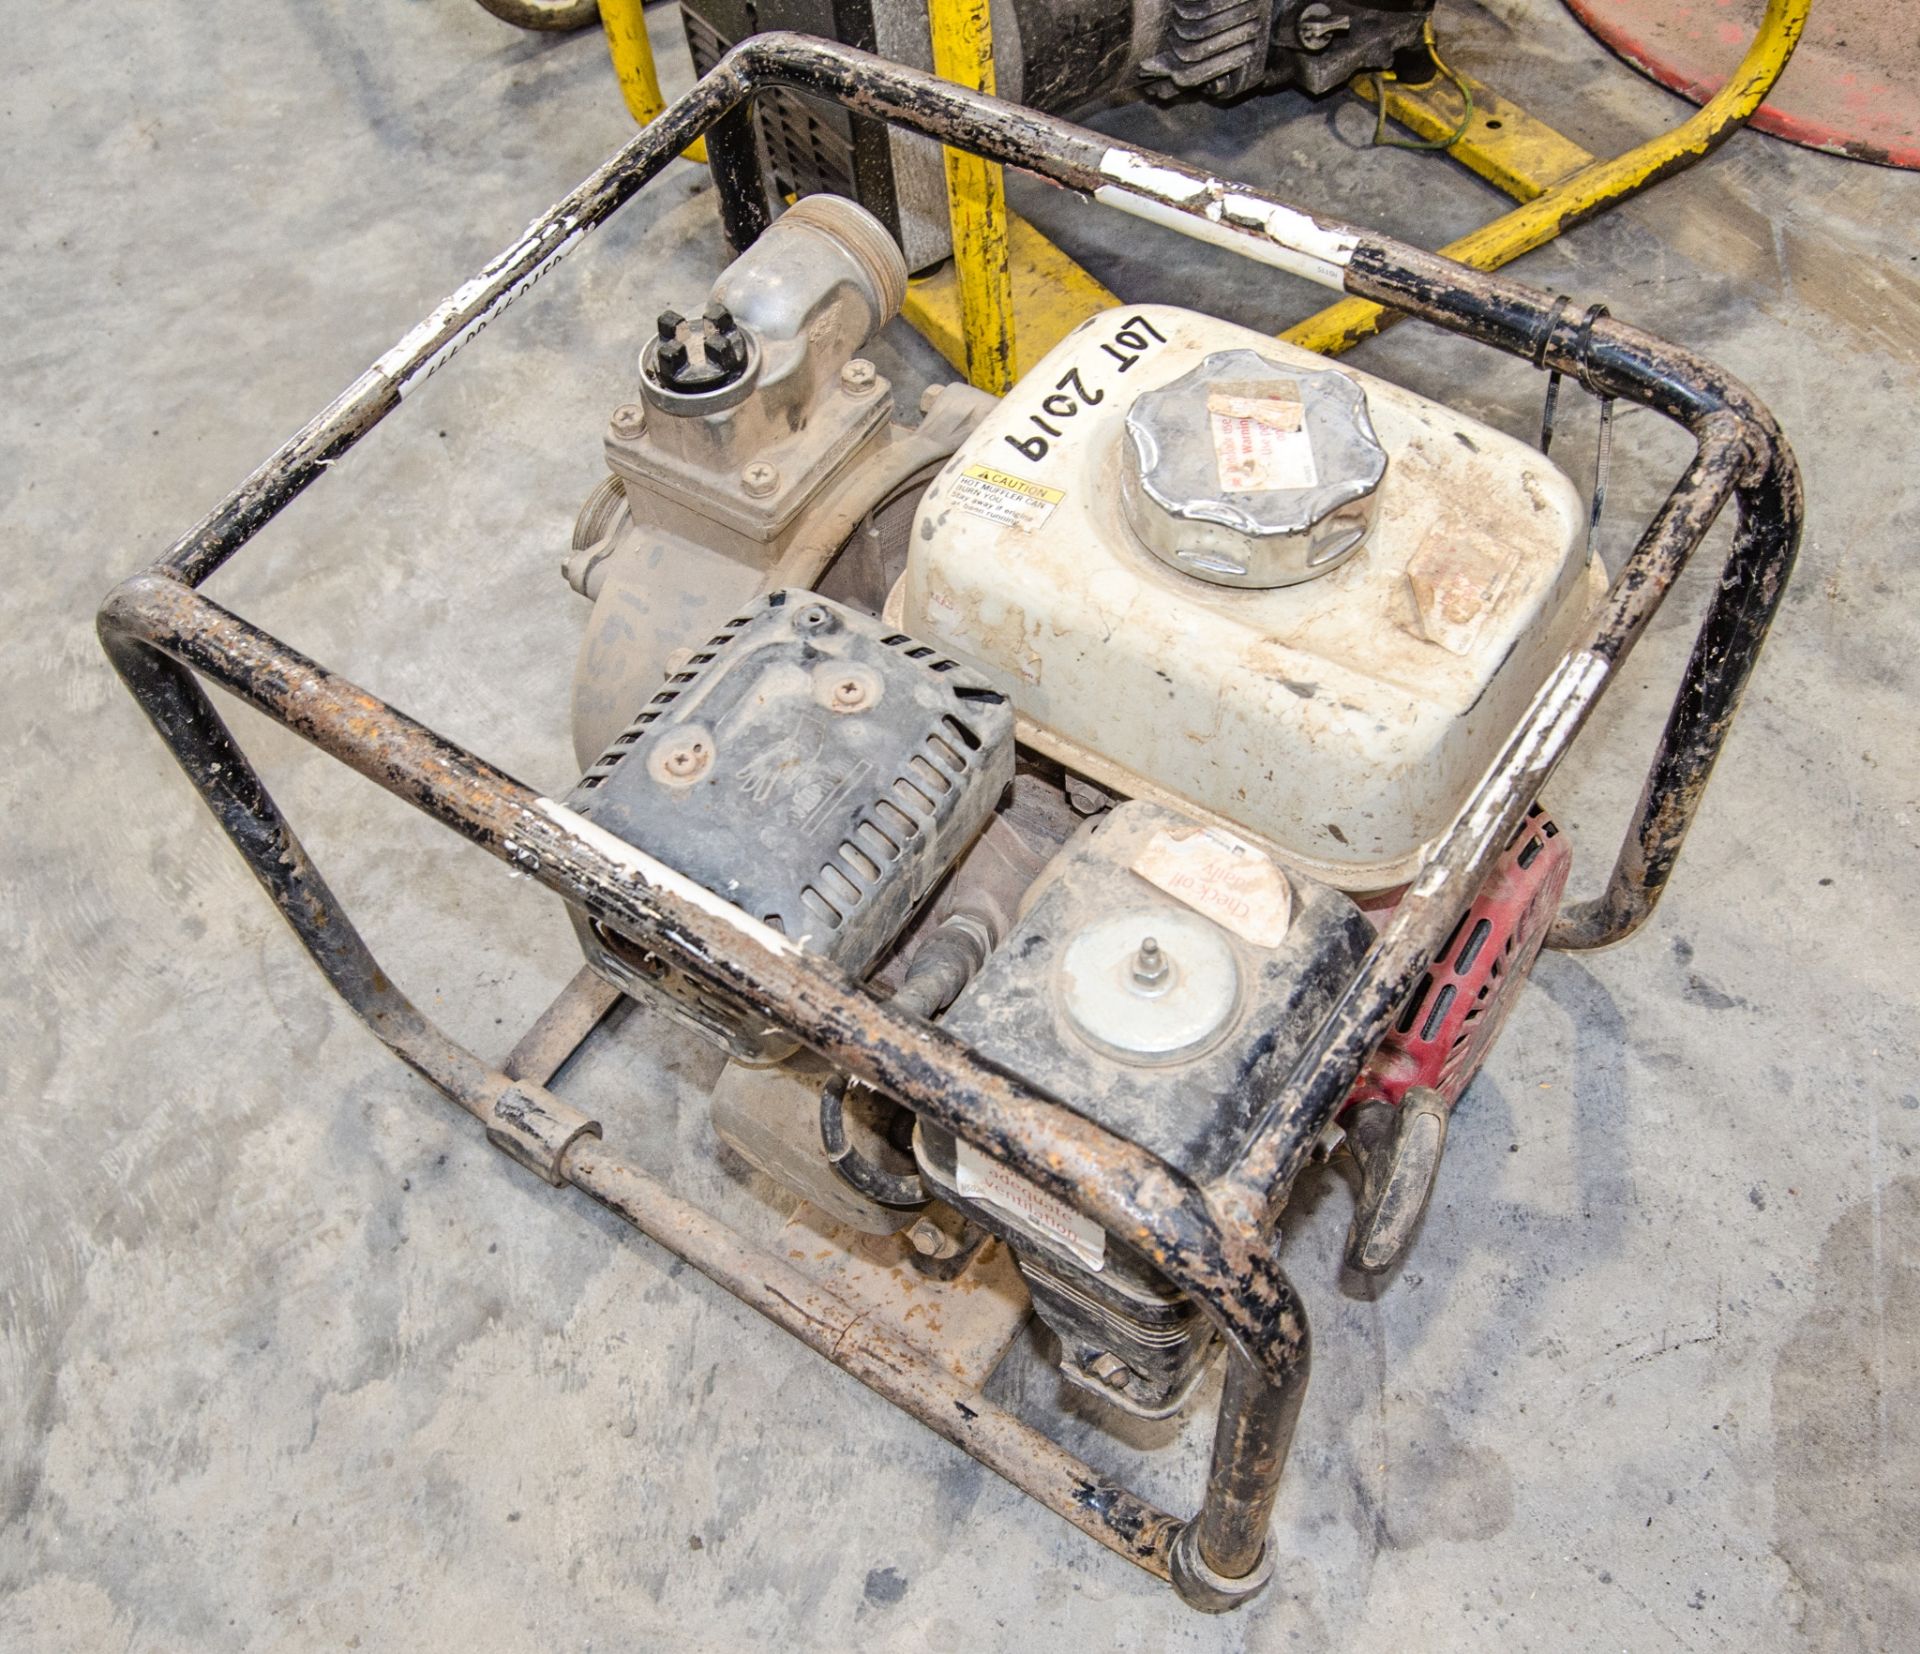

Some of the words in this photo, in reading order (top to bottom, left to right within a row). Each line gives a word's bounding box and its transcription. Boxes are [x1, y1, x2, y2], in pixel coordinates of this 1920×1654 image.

[1100, 315, 1167, 373] LOT
[1004, 367, 1104, 462] 2019
[960, 477, 980, 488] HOT
[982, 484, 1023, 502] MUFFLER
[1025, 498, 1046, 509] CAN
[992, 474, 1048, 498] CAUTION
[972, 499, 993, 510] away
[1168, 872, 1194, 889] oil
[1201, 860, 1248, 889] daily
[1201, 883, 1250, 918] Check
[984, 1177, 1079, 1244] ventilation
[989, 1169, 1072, 1222] adequate
